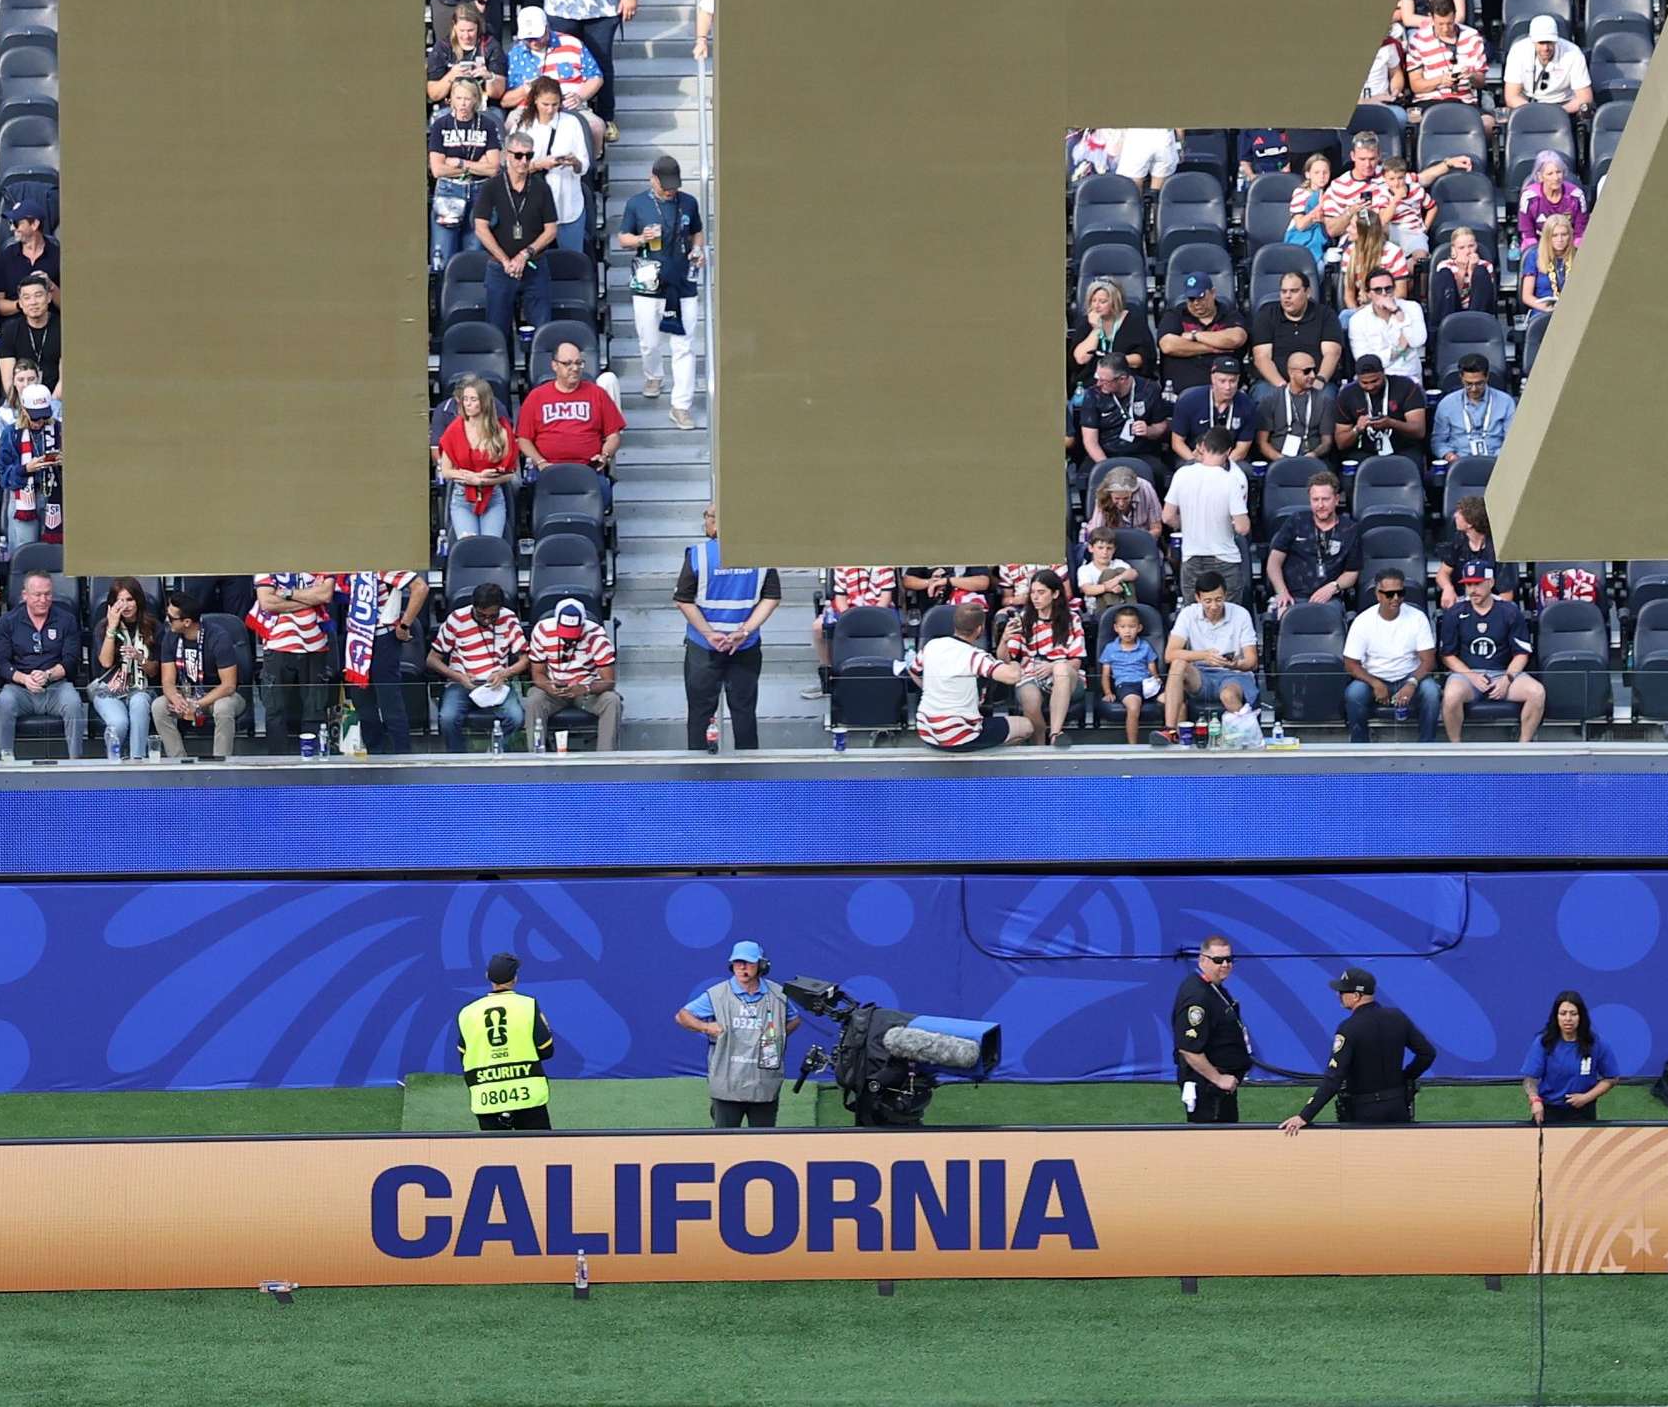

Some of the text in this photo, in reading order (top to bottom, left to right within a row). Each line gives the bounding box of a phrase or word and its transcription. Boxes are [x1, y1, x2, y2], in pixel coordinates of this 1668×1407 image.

[542, 401, 591, 425] LMU
[355, 571, 373, 622] USA
[480, 1086, 531, 1107] 08043
[370, 1157, 1100, 1260] CALIFORNIA
